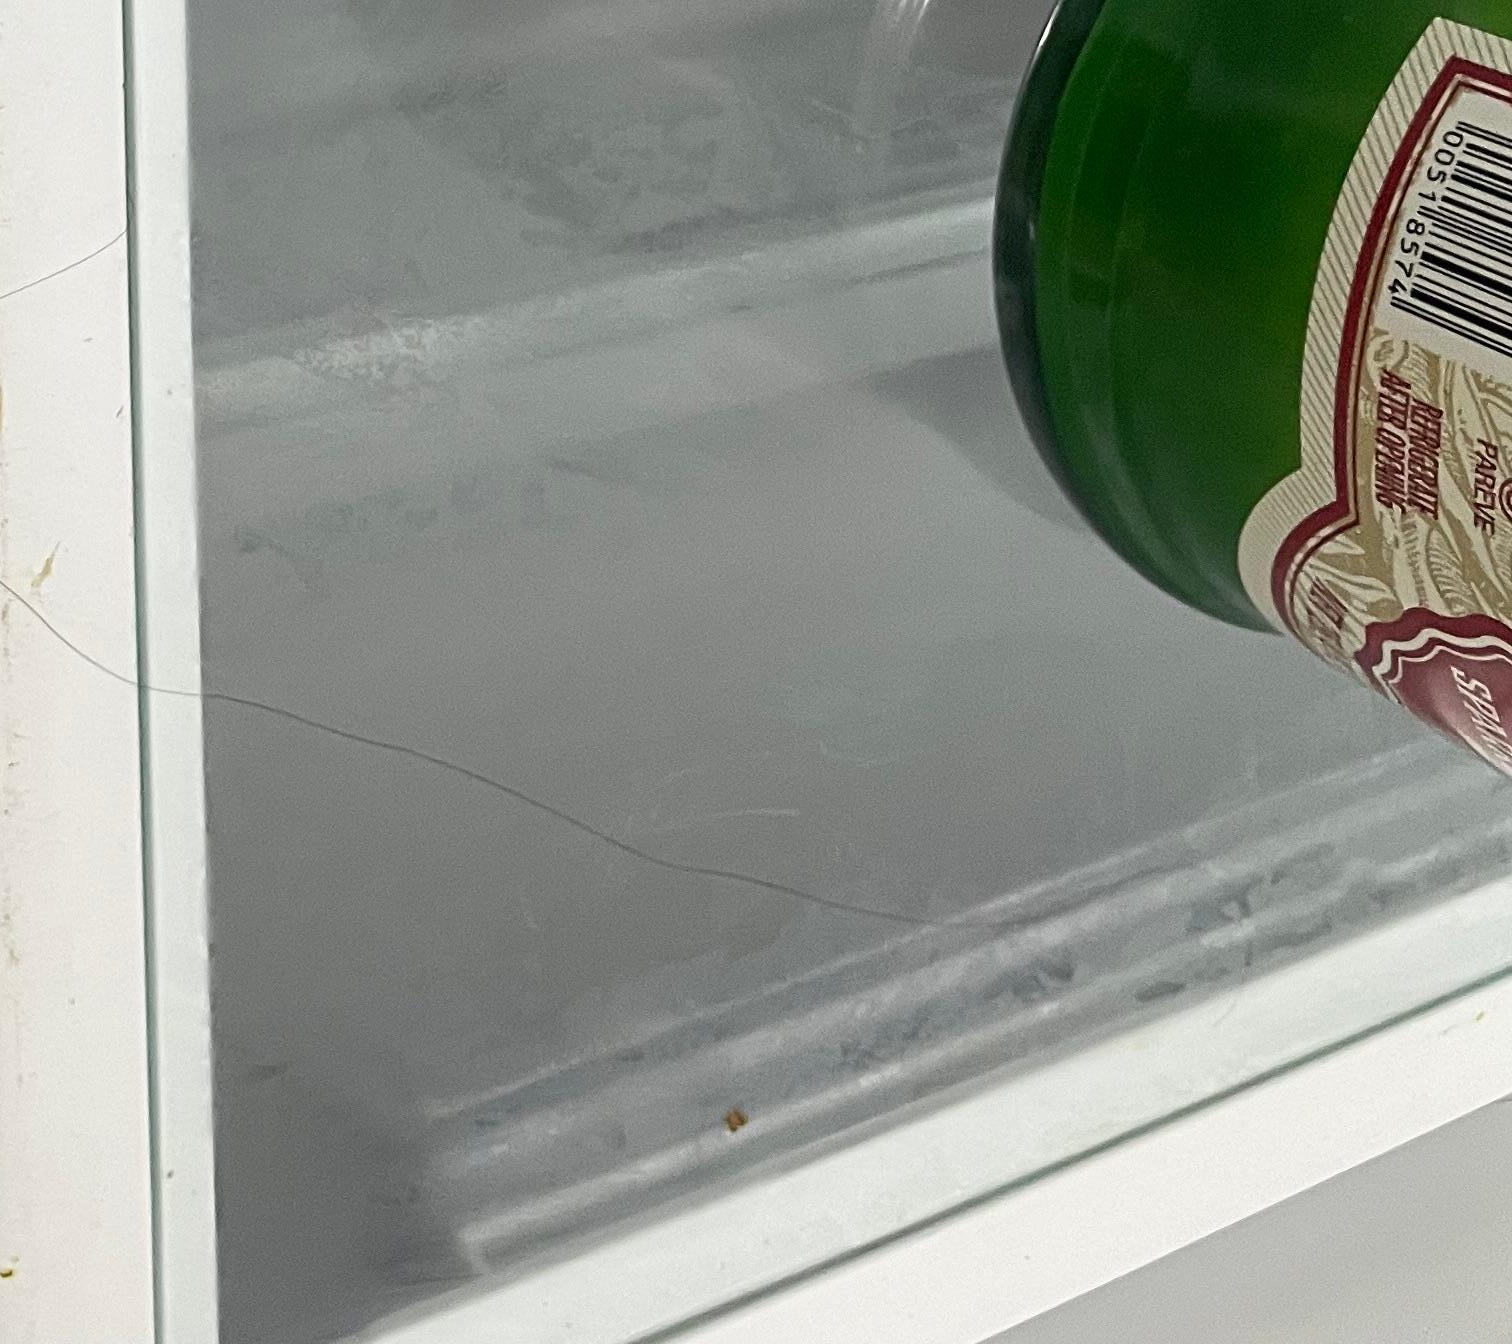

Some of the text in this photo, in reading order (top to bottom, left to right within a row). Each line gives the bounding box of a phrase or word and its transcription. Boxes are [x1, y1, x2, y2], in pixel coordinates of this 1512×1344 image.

[1375, 368, 1411, 514] AFTER OPENING
[1408, 398, 1443, 520] REFRIGERATE
[1474, 438, 1498, 537] PAREVE
